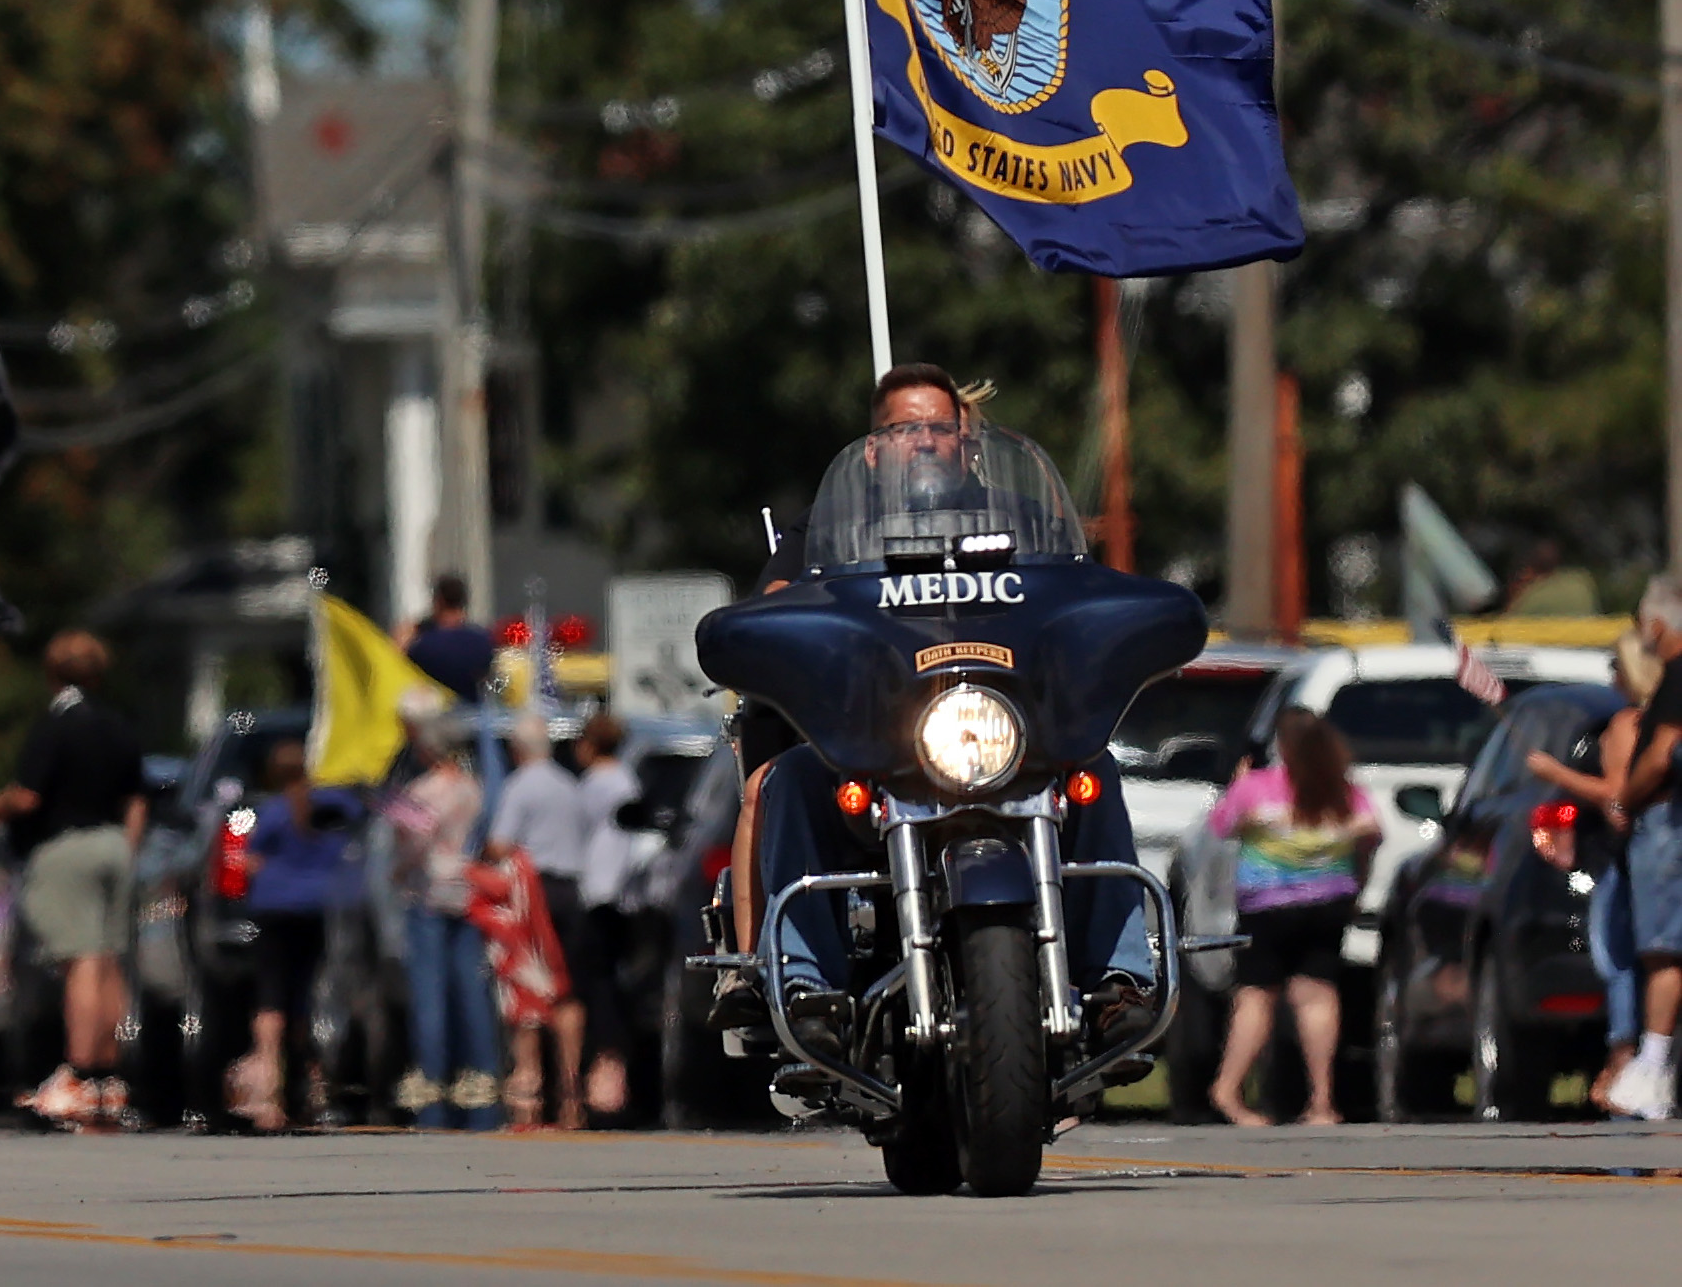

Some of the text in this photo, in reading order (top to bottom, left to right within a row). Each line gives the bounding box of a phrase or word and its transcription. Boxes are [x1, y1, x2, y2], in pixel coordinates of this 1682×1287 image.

[967, 141, 1117, 192] STATES NAVY
[878, 572, 1025, 608] MEDIC
